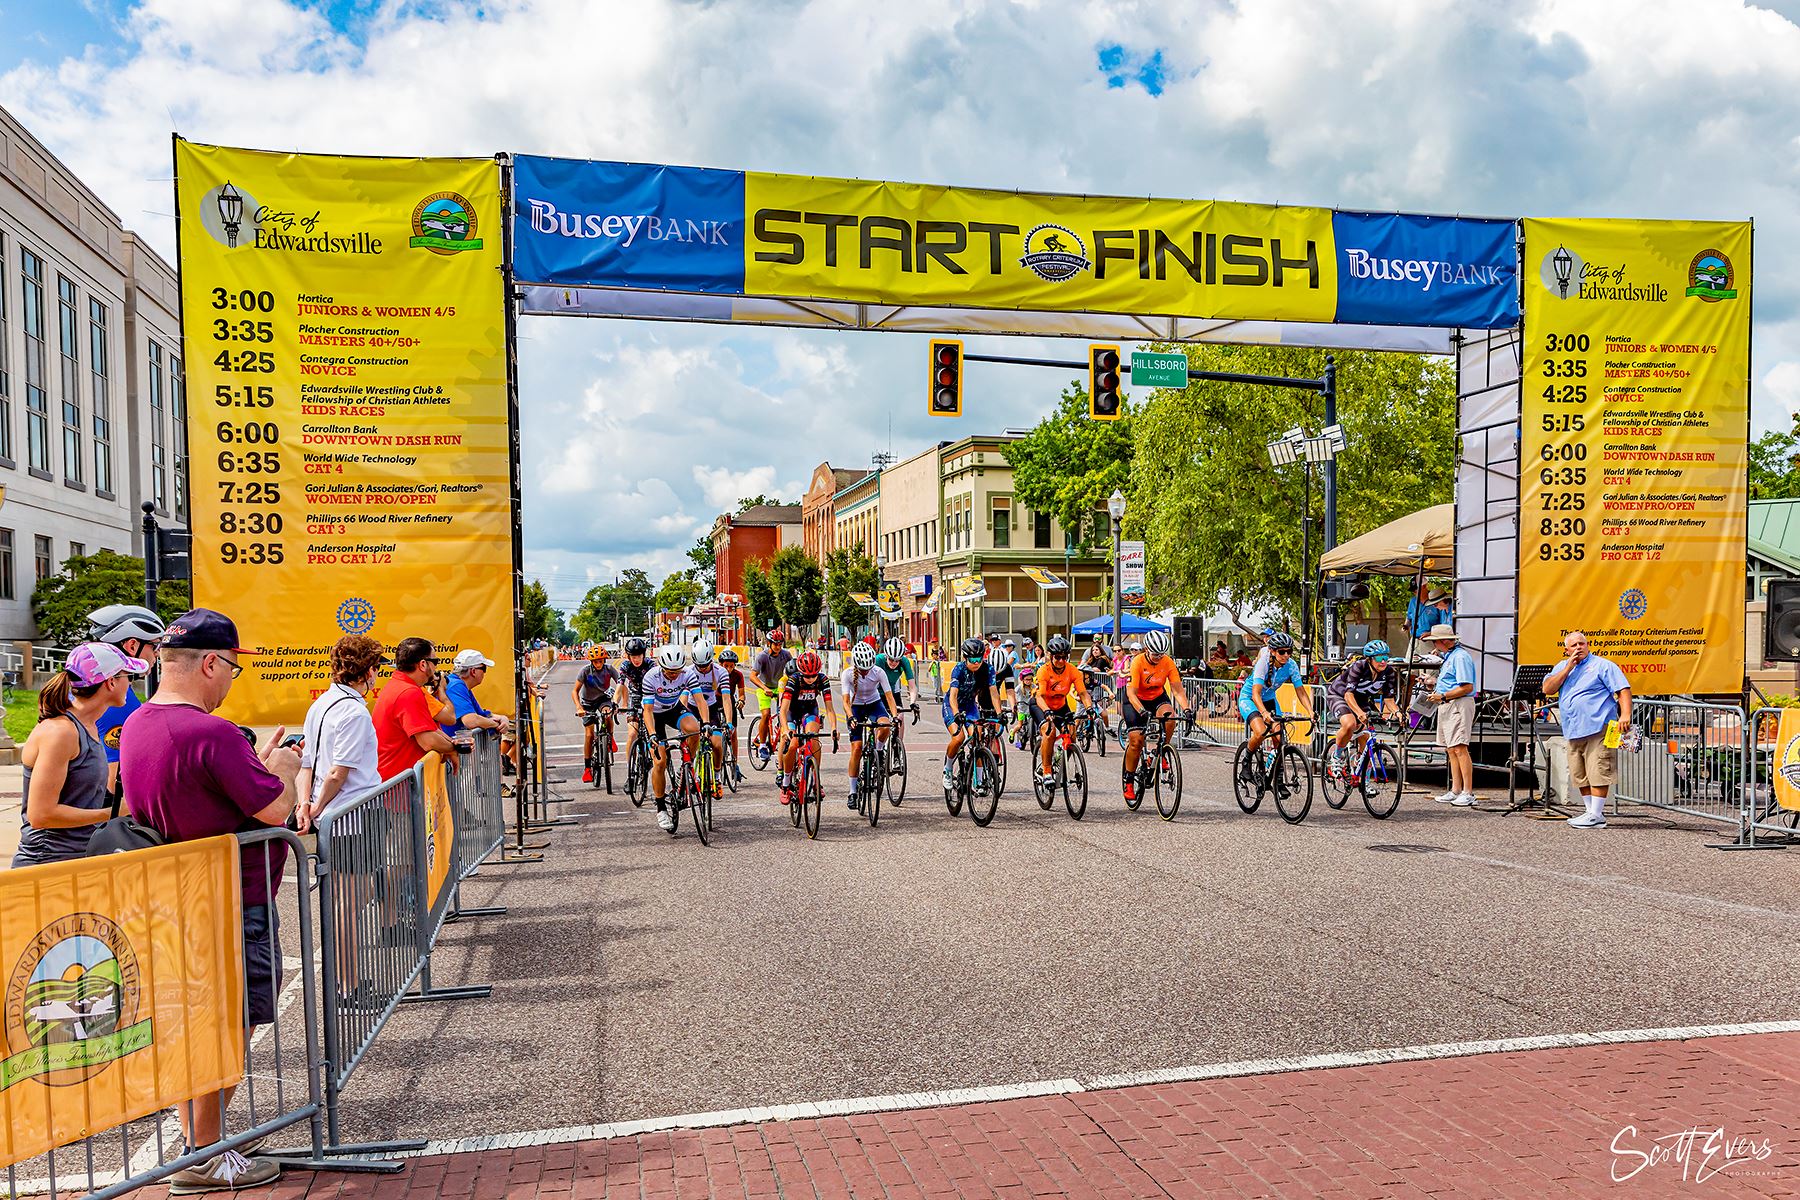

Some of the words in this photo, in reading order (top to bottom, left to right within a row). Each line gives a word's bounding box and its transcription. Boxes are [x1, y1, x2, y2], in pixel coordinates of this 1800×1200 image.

[253, 206, 296, 231] City
[300, 210, 320, 232] of
[253, 228, 383, 255] Edwardsville
[753, 207, 1022, 276] START
[1028, 255, 1051, 263] ROTARY
[1053, 255, 1083, 265] CRITERIUM
[1093, 228, 1318, 289] FINISH
[1579, 262, 1609, 284] City
[1612, 264, 1625, 285] of
[1578, 282, 1668, 302] Edwardsville
[211, 287, 275, 312] 3:00
[298, 294, 333, 303] Hortica
[298, 304, 358, 316] JUNIORS
[375, 307, 431, 317] WOMEN
[434, 307, 456, 316] 4/5
[212, 318, 274, 343] 3:35
[299, 324, 336, 334] Plocher
[338, 326, 400, 335] Construction
[299, 335, 365, 347] MASTERS
[368, 338, 420, 347] 40+/50+
[1545, 333, 1590, 352] 3:00
[1605, 344, 1646, 354] JUNIORS
[1660, 345, 1699, 353] WOMEN
[1701, 345, 1717, 353] 4/5
[213, 350, 276, 373] 4:25
[300, 354, 345, 366] Contegra
[348, 356, 408, 365] Construction
[1132, 358, 1186, 370] HILLSBORO
[300, 365, 356, 376] NOVICE
[1542, 360, 1588, 378] 3:35
[1653, 370, 1690, 378] 40+/50+
[301, 384, 363, 394] Edwardsville
[366, 386, 410, 396] Wrestling
[412, 386, 433, 394] Club
[1542, 385, 1588, 403] 4:25
[1604, 386, 1635, 394] Contegra
[215, 384, 274, 408] 5:15
[301, 395, 353, 406] Fellowship
[356, 396, 366, 405] of
[369, 396, 411, 405] Christian
[413, 396, 450, 404] Athletes
[1604, 394, 1644, 402] NOVICE
[301, 405, 336, 415] KIDS
[339, 406, 385, 416] RACES
[1649, 411, 1681, 419] Wrestling
[302, 424, 350, 433] Carrollton
[1542, 414, 1585, 432] 5:15
[1603, 419, 1641, 427] Fellowship
[216, 421, 279, 445] 6:00
[1604, 427, 1628, 435] KIDS
[1631, 428, 1662, 436] RACES
[302, 435, 392, 445] DOWNTOWN
[395, 436, 431, 445] DASH
[434, 435, 462, 445] RUN
[1540, 443, 1587, 461] 6:00
[1604, 443, 1638, 451] Carrollton
[304, 453, 332, 462] World
[335, 454, 359, 462] Wide
[362, 454, 417, 465] Technology
[1604, 452, 1667, 460] DOWNTOWN
[1668, 453, 1693, 461] DASH
[1695, 453, 1715, 461] RUN
[217, 451, 281, 475] 6:35
[304, 464, 332, 474] CAT
[1645, 469, 1682, 477] Technology
[1540, 468, 1587, 486] 6:35
[1604, 477, 1624, 485] CAT
[218, 481, 281, 505] 7:25
[305, 484, 326, 492] Gori
[327, 484, 354, 492] Julian
[366, 484, 439, 493] Associates/Gori,
[305, 494, 362, 504] WOMEN
[365, 494, 436, 504] PRO/OPEN
[1540, 493, 1585, 511] 7:25
[1603, 502, 1644, 510] WOMEN
[1645, 502, 1695, 510] PRO/OPEN
[219, 512, 283, 534] 8:30
[306, 514, 341, 524] Phillips
[344, 515, 356, 523] 66
[358, 514, 386, 523] Wood
[388, 515, 412, 523] River
[414, 514, 453, 524] Refinery
[1602, 519, 1627, 527] Phillips
[1678, 519, 1706, 527] Refinery
[307, 525, 334, 534] CAT
[1540, 518, 1586, 536] 8:30
[221, 542, 285, 565] 9:35
[307, 544, 353, 553] Anderson
[357, 544, 396, 554] Hospital
[1540, 543, 1585, 561] 9:35
[1635, 544, 1664, 552] Hospital
[308, 554, 336, 564] PRO
[341, 554, 367, 564] CAT
[372, 554, 392, 563] 1/2
[1601, 552, 1621, 560] PRO
[1624, 552, 1643, 560] CAT
[1646, 552, 1661, 560] 1/2
[1620, 629, 1644, 637] Rotary
[1646, 628, 1677, 636] Criterium
[1604, 639, 1633, 647] possible
[1632, 648, 1667, 656] wonderful
[252, 659, 282, 668] would
[285, 659, 303, 667] not
[1641, 664, 1666, 672] YOU!
[260, 672, 300, 681] support
[7, 917, 87, 1030] EDWARDSVILLE
[91, 919, 138, 997] TOWNSHIP
